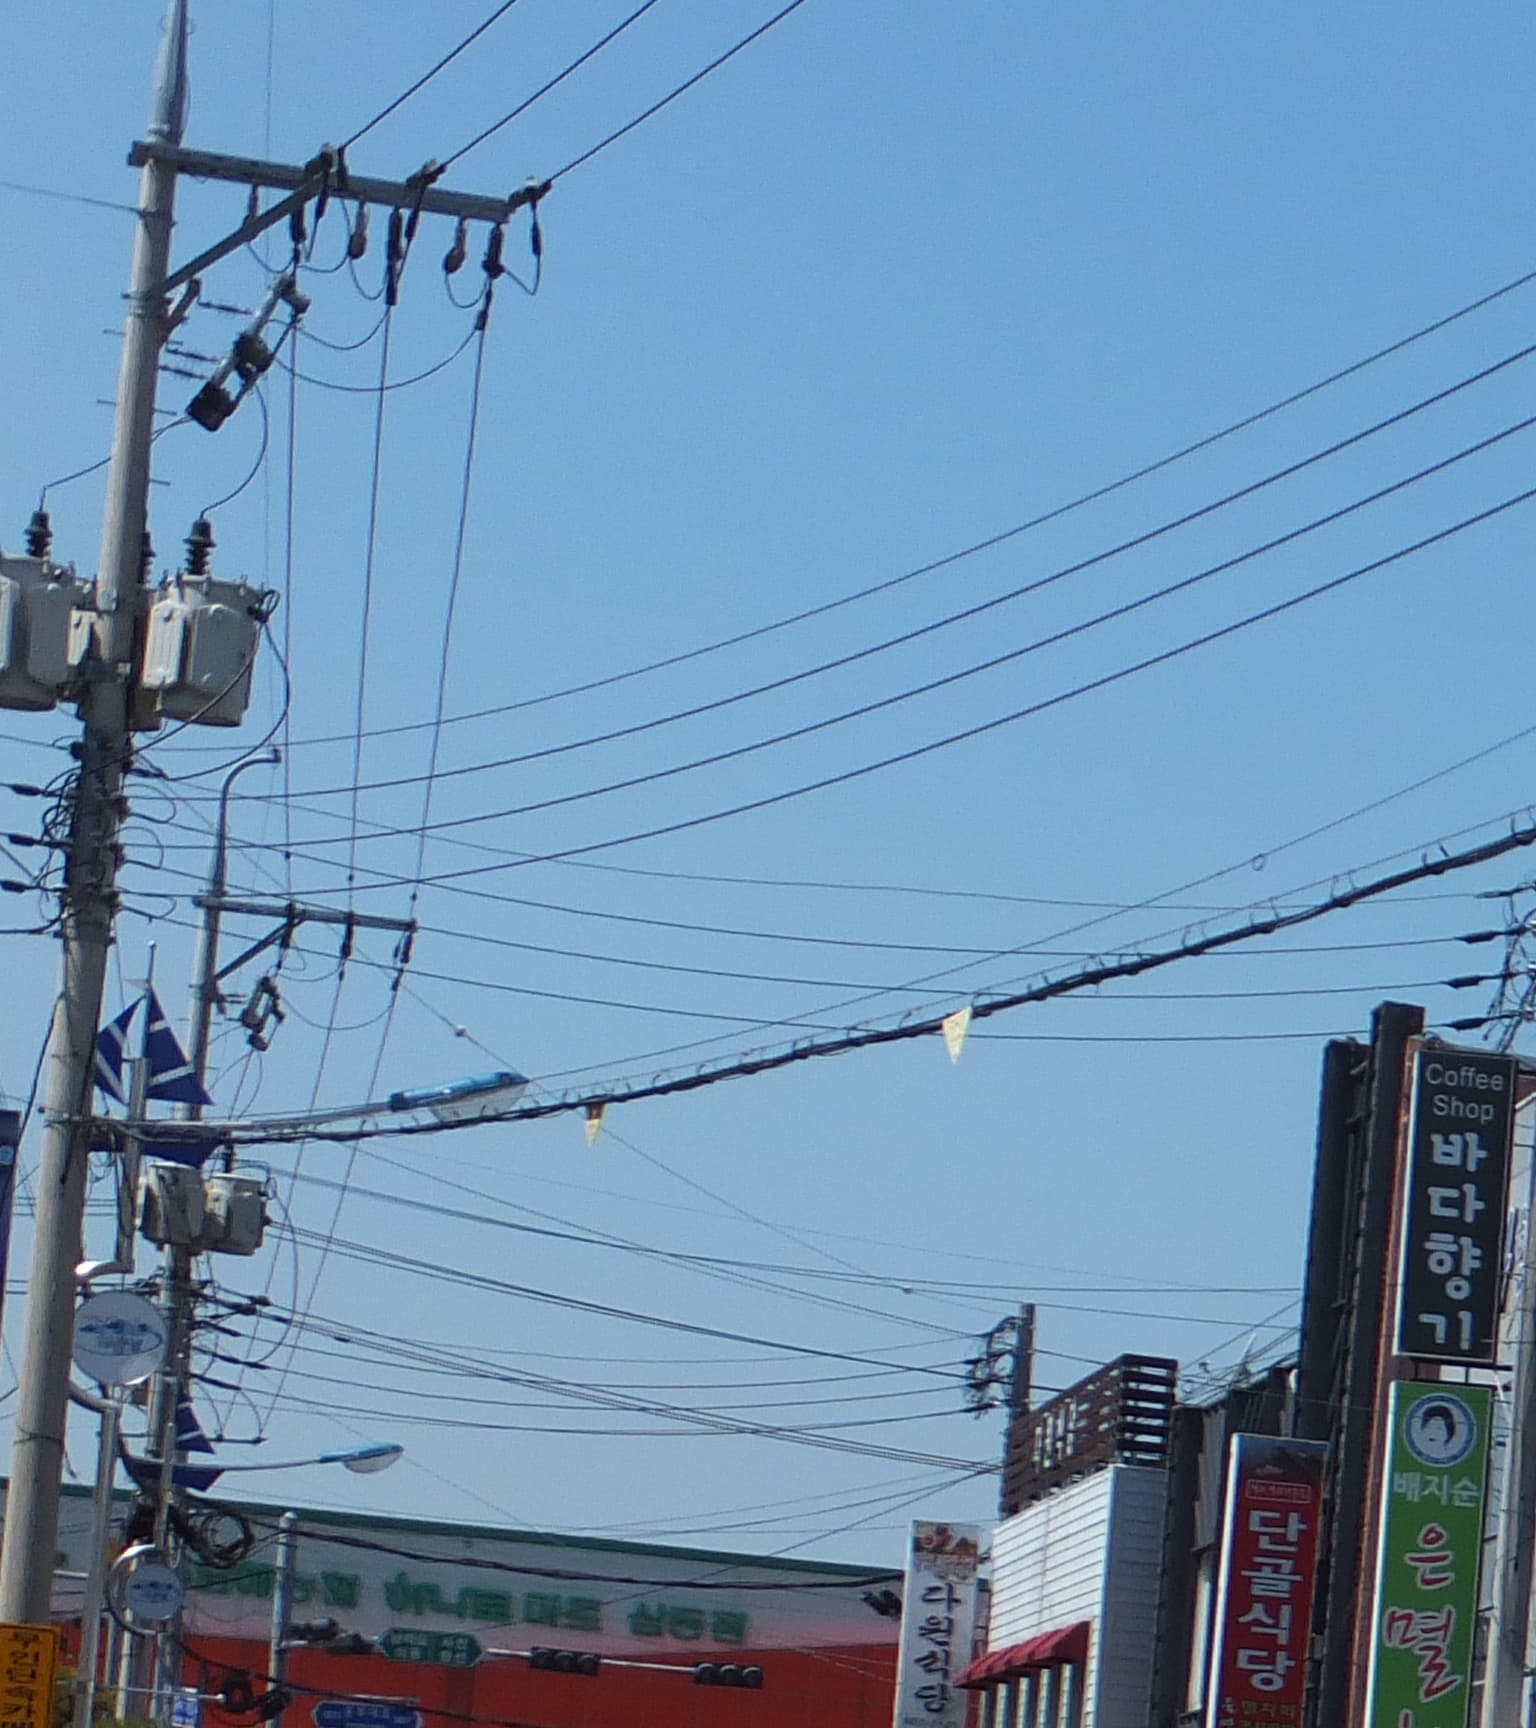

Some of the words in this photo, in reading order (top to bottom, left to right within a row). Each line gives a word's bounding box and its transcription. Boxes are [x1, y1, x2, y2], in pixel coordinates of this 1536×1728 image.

[1425, 1063, 1505, 1093] Coffee
[1432, 1094, 1496, 1124] Shop
[1418, 1130, 1488, 1351] 바다향기
[1393, 1471, 1480, 1509] 배지순
[1236, 1509, 1307, 1693] 단골식당
